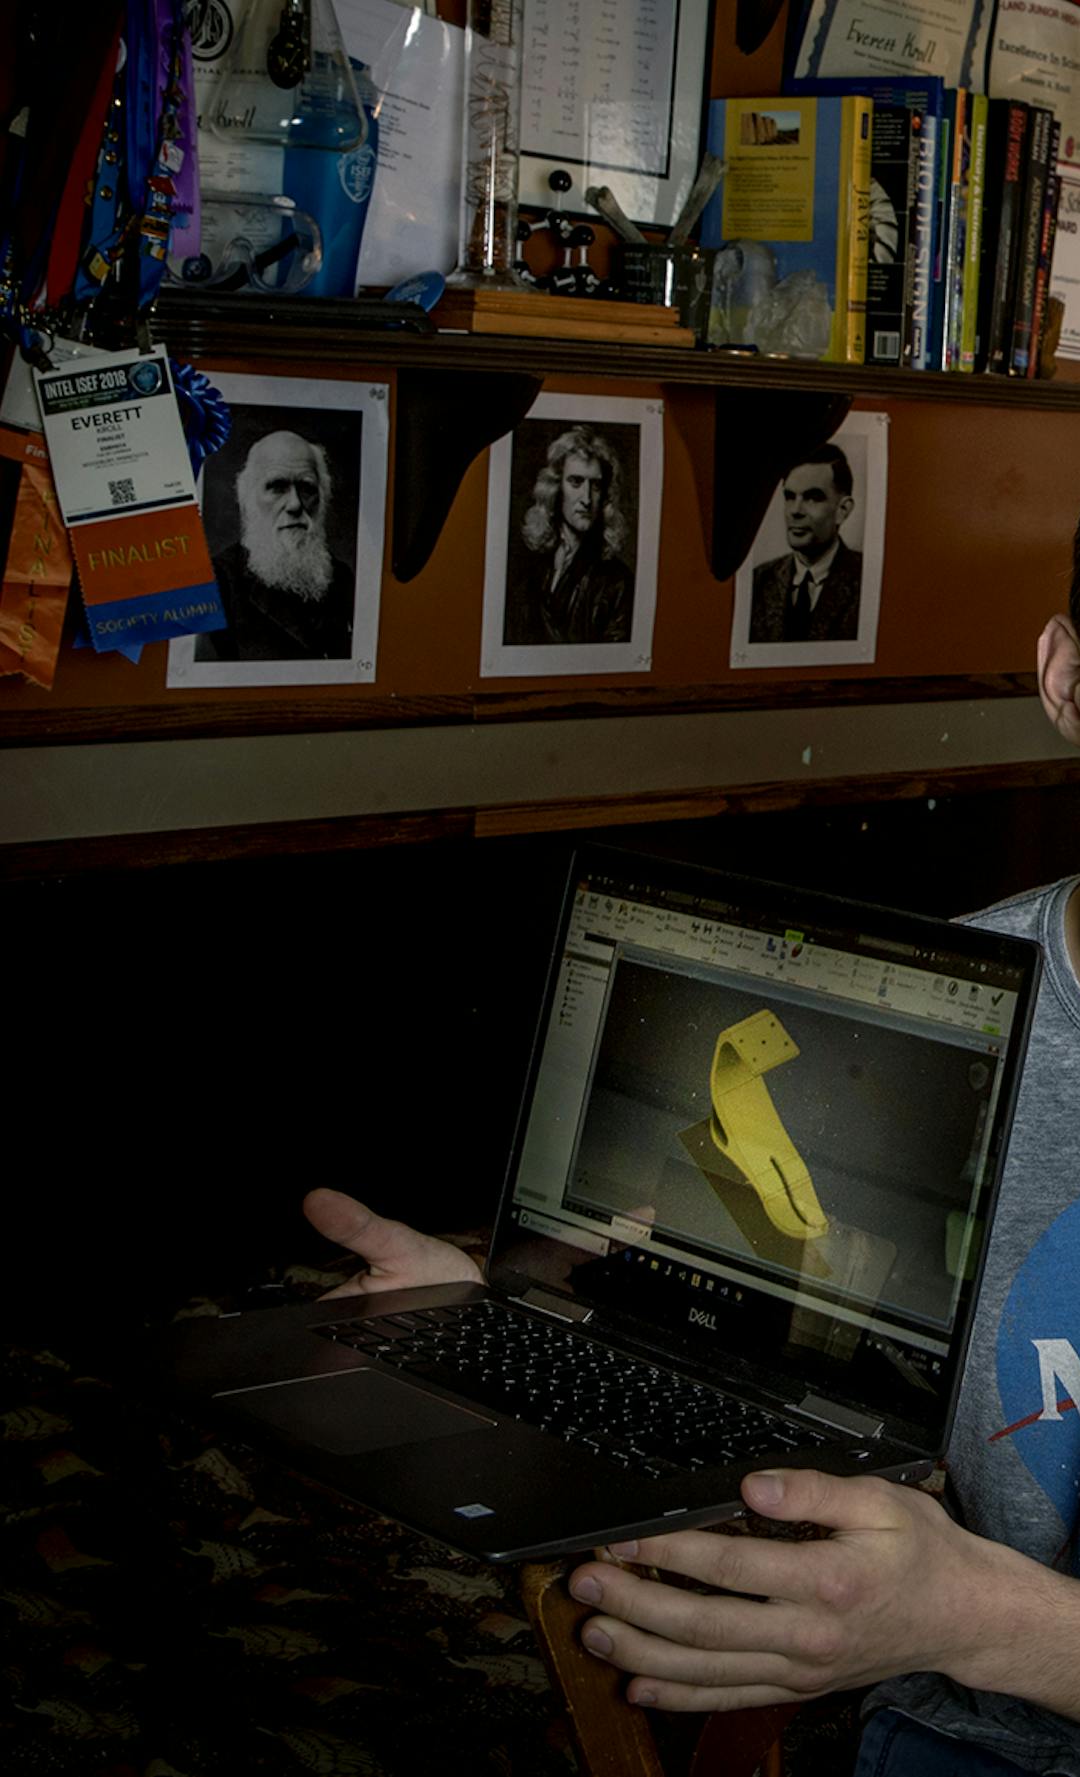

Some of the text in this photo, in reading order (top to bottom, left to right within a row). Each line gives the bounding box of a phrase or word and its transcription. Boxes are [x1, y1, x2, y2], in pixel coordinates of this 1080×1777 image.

[846, 18, 897, 53] Everett
[900, 31, 937, 64] Kroll
[998, 38, 1048, 62] Excellence
[1050, 52, 1060, 64] In
[1005, 142, 1021, 182] WORKS
[968, 123, 985, 264] Electricity & Electronics
[854, 184, 870, 242] Java
[911, 137, 935, 321] BIO DESIGN
[1022, 177, 1042, 307] ASTRONOMY TODAY
[43, 369, 128, 399] INTEL ISEF 2018
[71, 406, 143, 430] EVERETT
[96, 424, 122, 434] KROLL
[96, 433, 125, 444] FINALIST
[87, 535, 192, 572] FINALIST
[95, 600, 219, 635] SOCIETY ALUMNI
[687, 1307, 718, 1330] DELL
